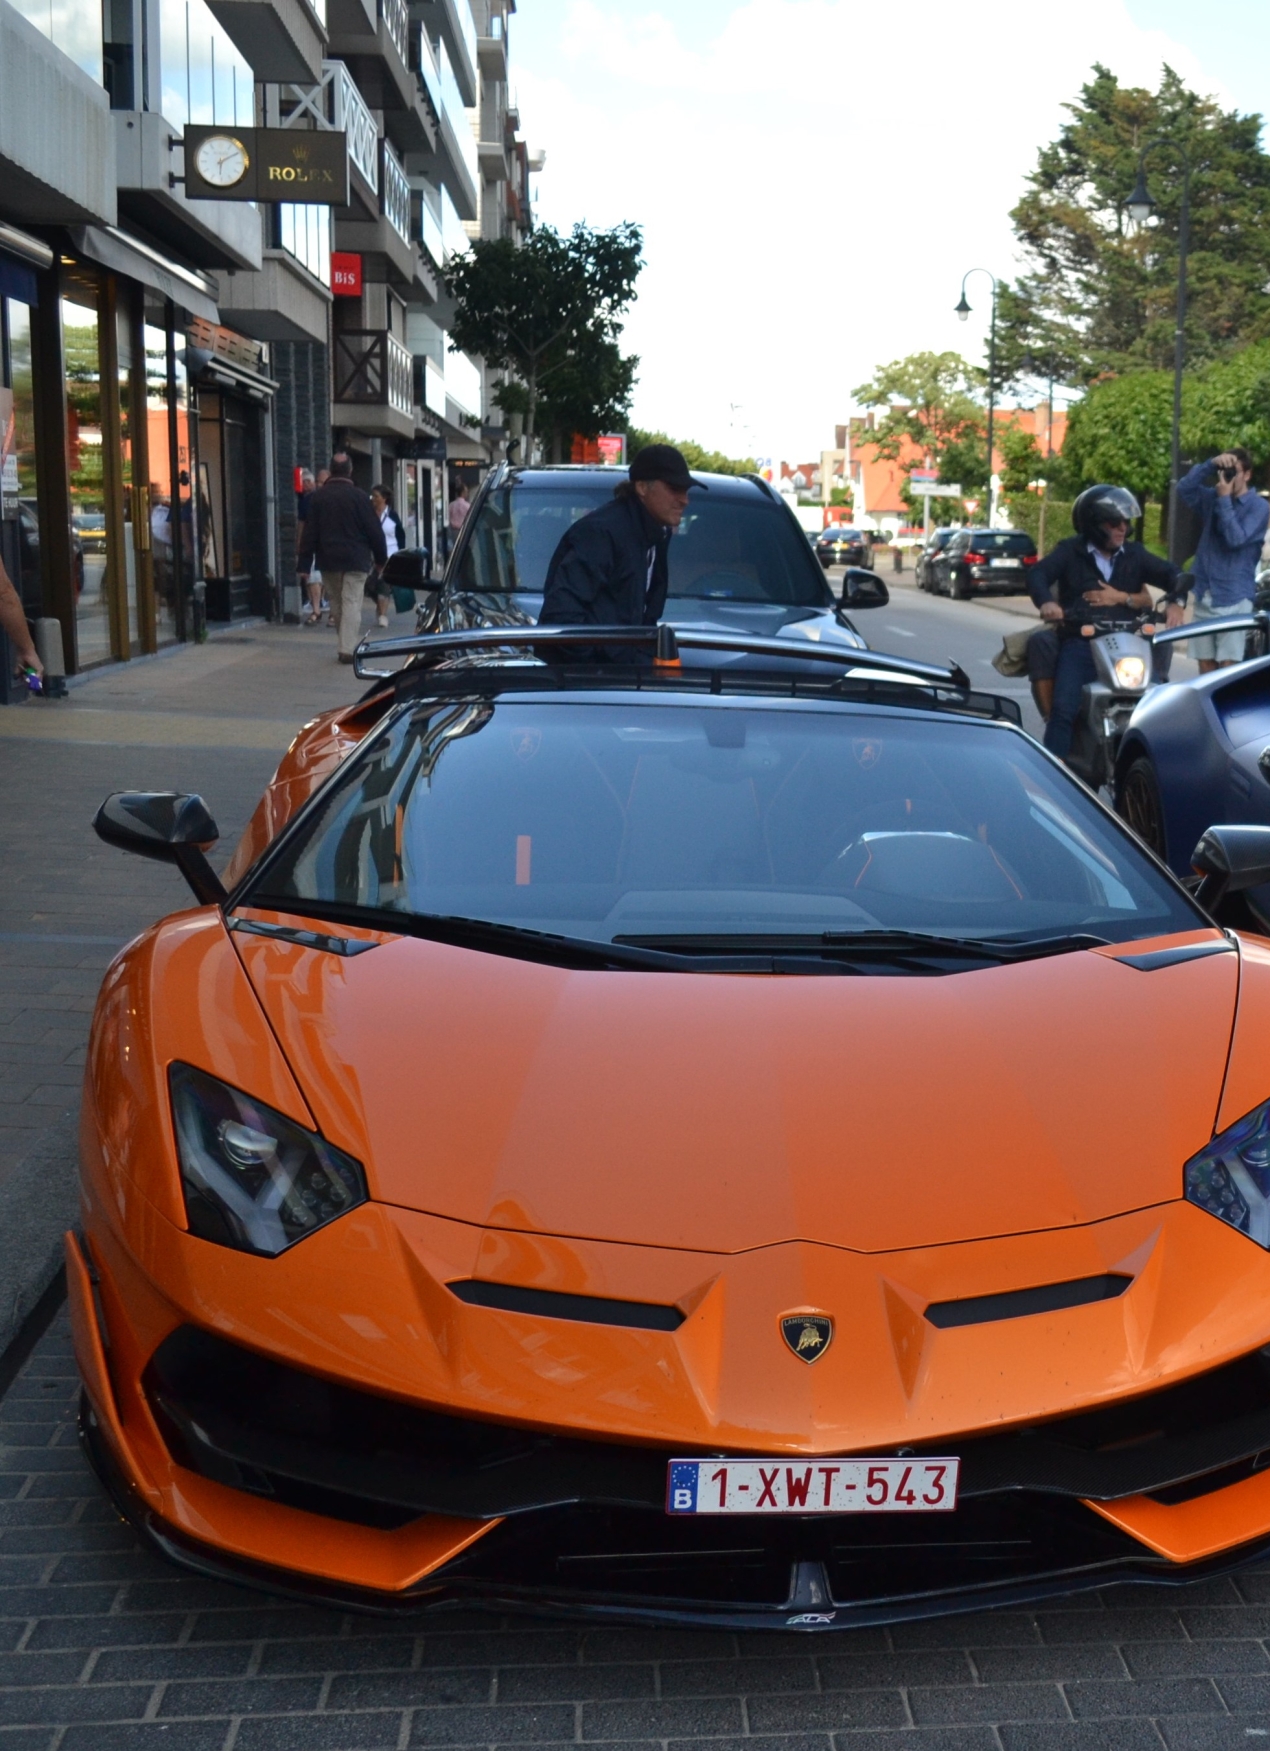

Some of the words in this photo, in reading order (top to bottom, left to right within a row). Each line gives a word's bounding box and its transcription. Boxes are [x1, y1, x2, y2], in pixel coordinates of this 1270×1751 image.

[268, 166, 333, 182] ROLEX
[784, 1317, 829, 1327] LAMBORGHINI
[673, 1489, 693, 1509] B
[711, 1466, 947, 1507] 1-XWT-543
